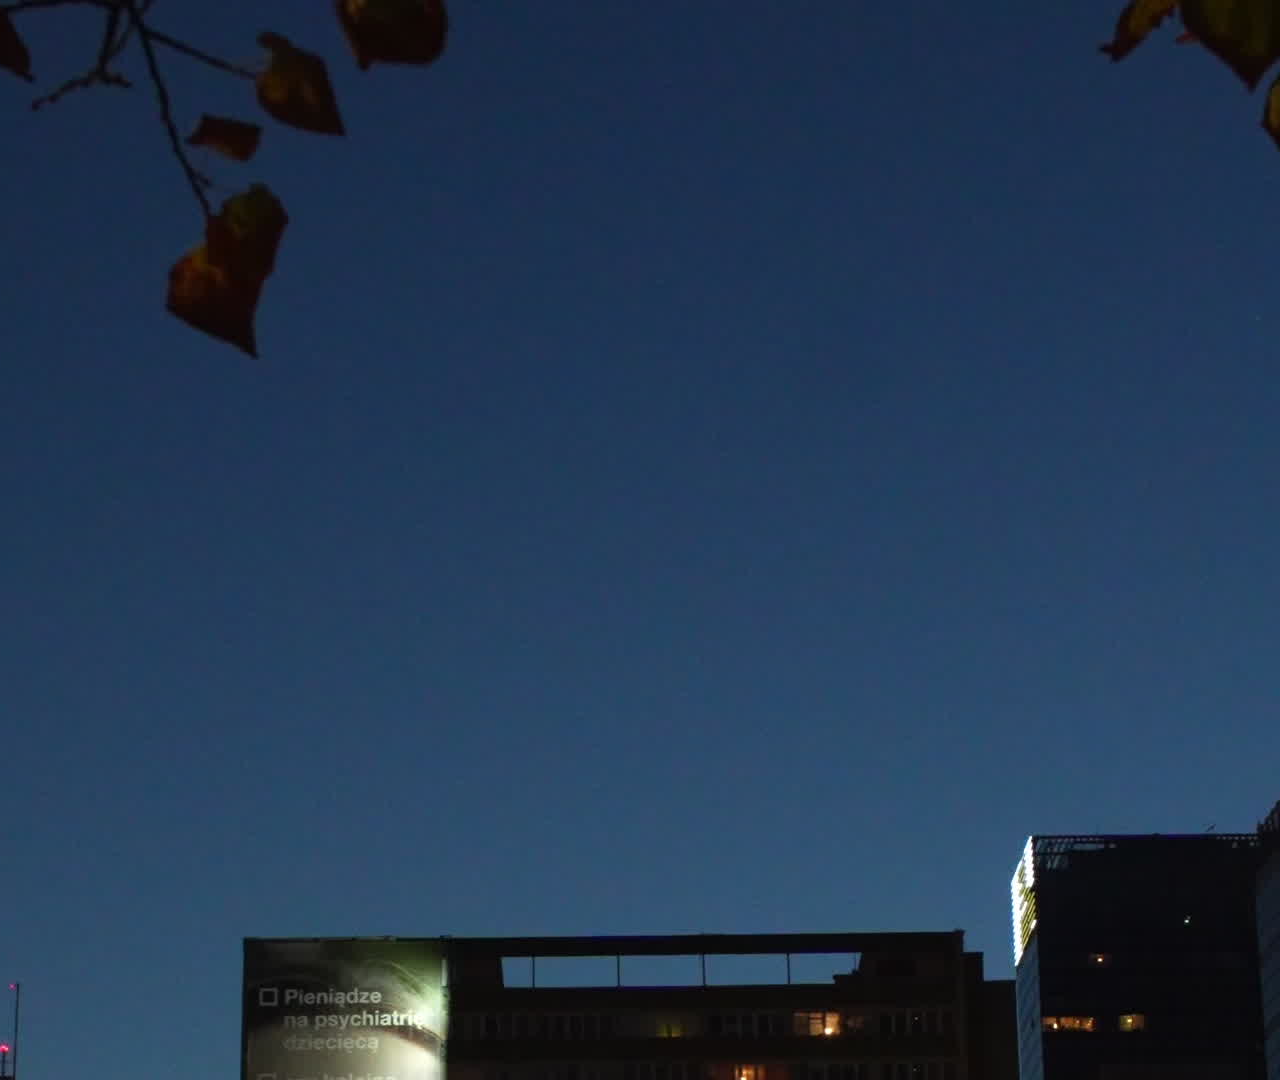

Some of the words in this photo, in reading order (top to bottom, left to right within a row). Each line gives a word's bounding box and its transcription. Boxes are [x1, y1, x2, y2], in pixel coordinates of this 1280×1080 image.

[284, 988, 382, 1008] Pieniądze
[283, 1014, 308, 1028] na
[314, 1010, 425, 1031] psychiatrię
